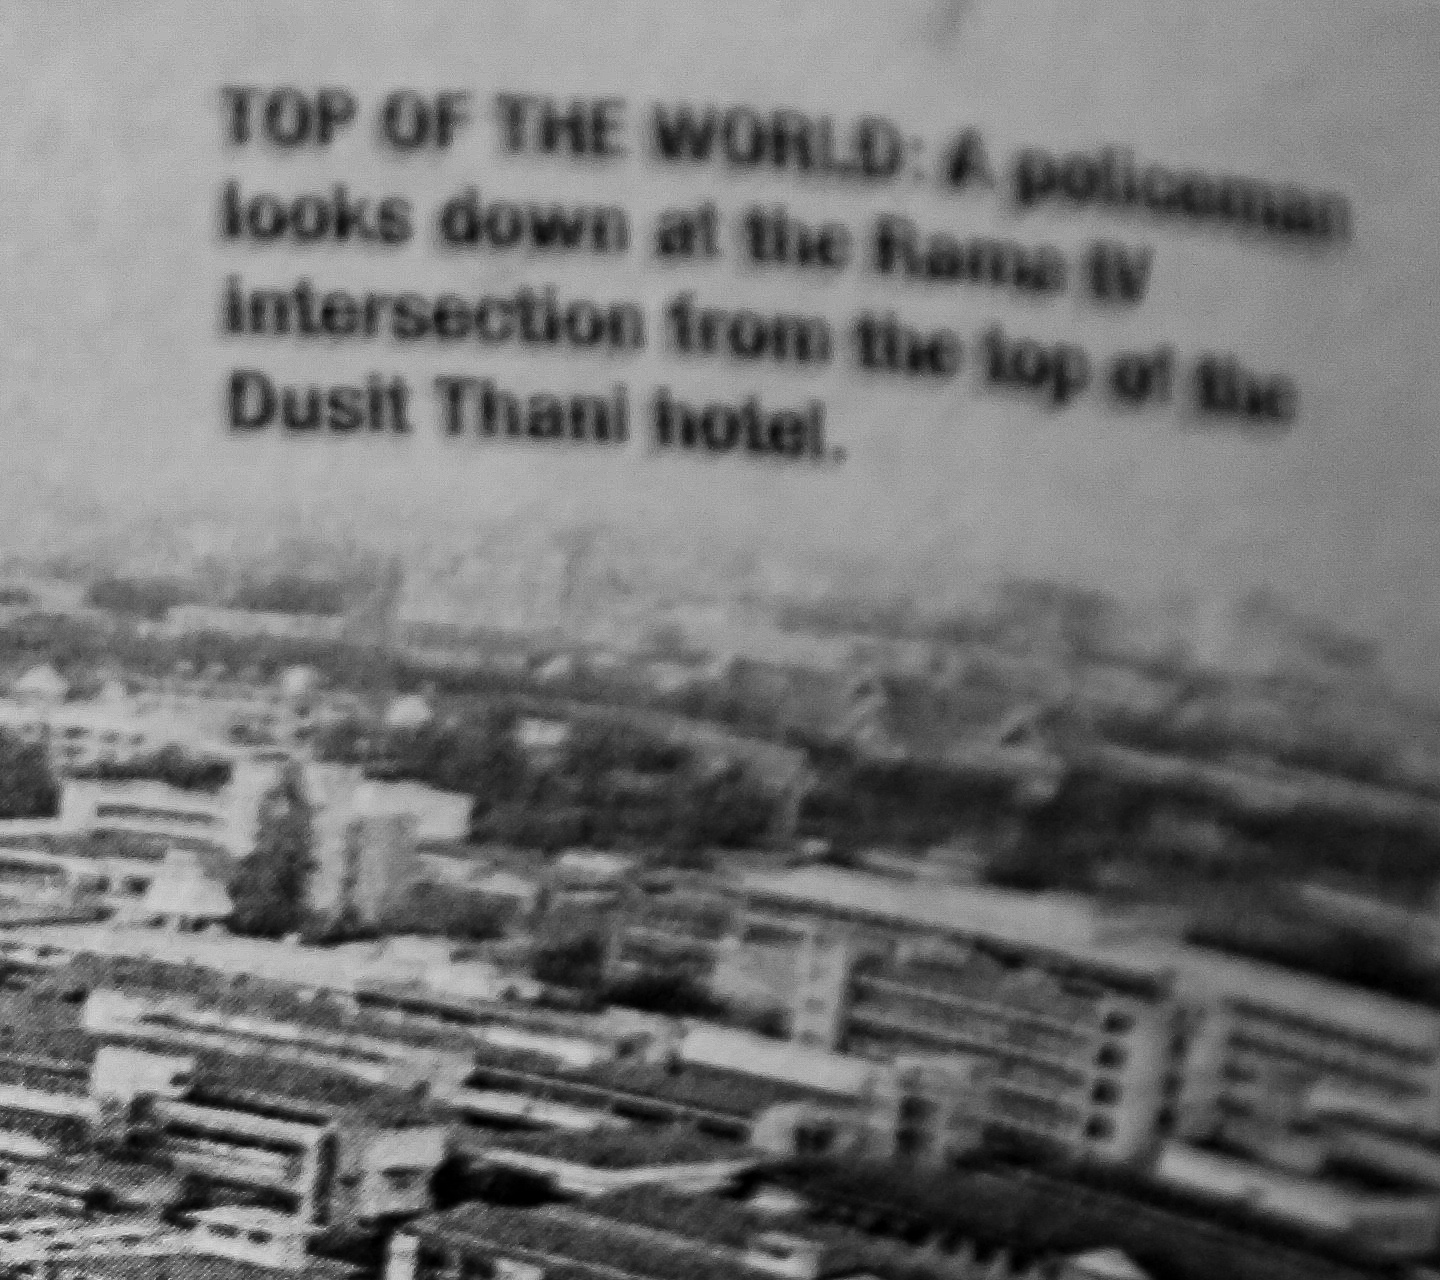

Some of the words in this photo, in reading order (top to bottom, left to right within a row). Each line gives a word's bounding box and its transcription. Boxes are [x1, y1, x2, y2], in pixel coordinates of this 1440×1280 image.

[217, 84, 358, 157] TOP
[374, 89, 472, 159] OF
[492, 91, 628, 168] THE
[643, 103, 923, 190] WORLD:
[934, 128, 1002, 197] A
[216, 179, 415, 251] looks
[432, 186, 631, 259] down
[648, 201, 723, 268] at
[734, 204, 855, 279] the
[863, 213, 1071, 302] Rama
[1076, 240, 1153, 310] IV
[217, 274, 648, 359] intersection
[663, 292, 837, 370] from
[842, 310, 968, 386] the
[970, 326, 1096, 413] top
[1097, 346, 1179, 414] of
[1182, 354, 1299, 431] the
[222, 367, 414, 439] Dusit
[432, 373, 631, 448] Thani
[646, 385, 847, 467] hotel.
